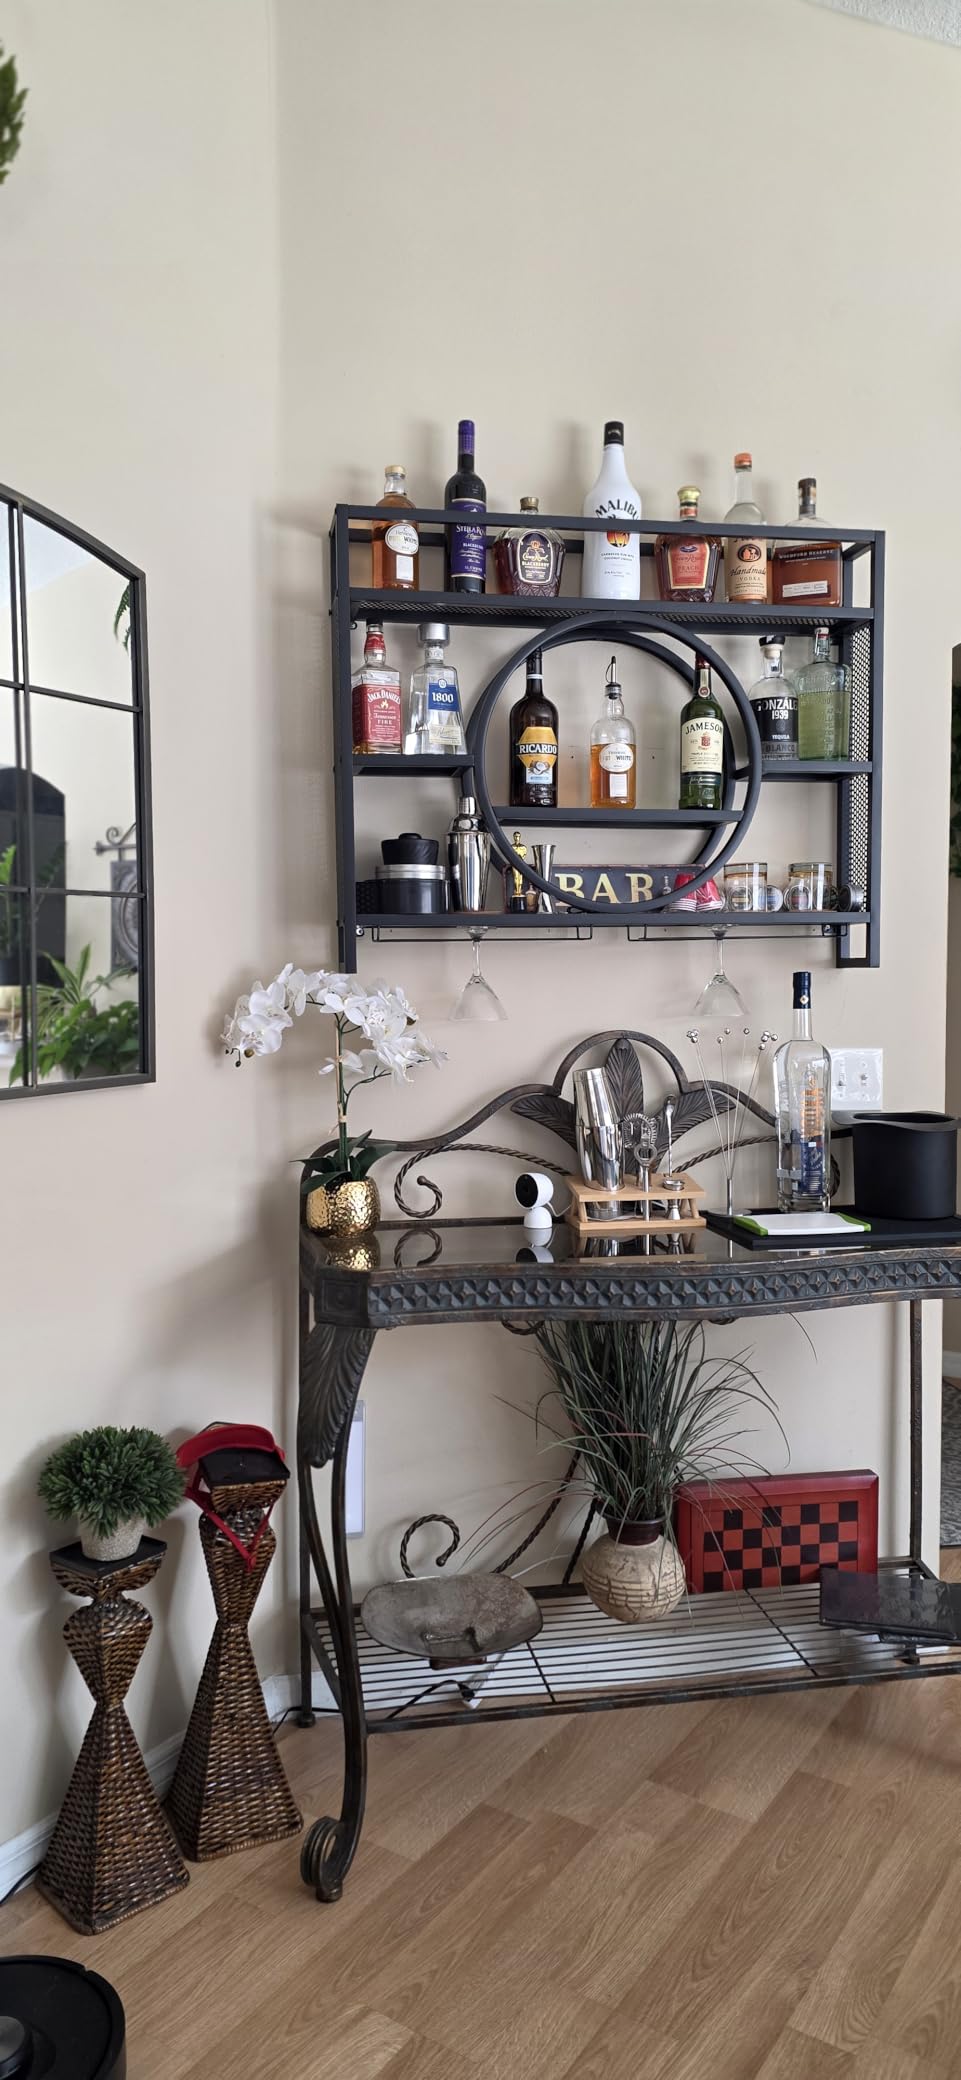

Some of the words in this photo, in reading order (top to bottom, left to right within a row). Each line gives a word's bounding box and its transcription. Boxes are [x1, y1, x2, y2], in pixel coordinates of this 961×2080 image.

[595, 499, 640, 520] MALIBU
[432, 692, 454, 703] 1800
[771, 709, 789, 720] 1939
[685, 721, 723, 735] JAMESON
[519, 743, 557, 755] RICARDO
[554, 873, 655, 906] BAR
